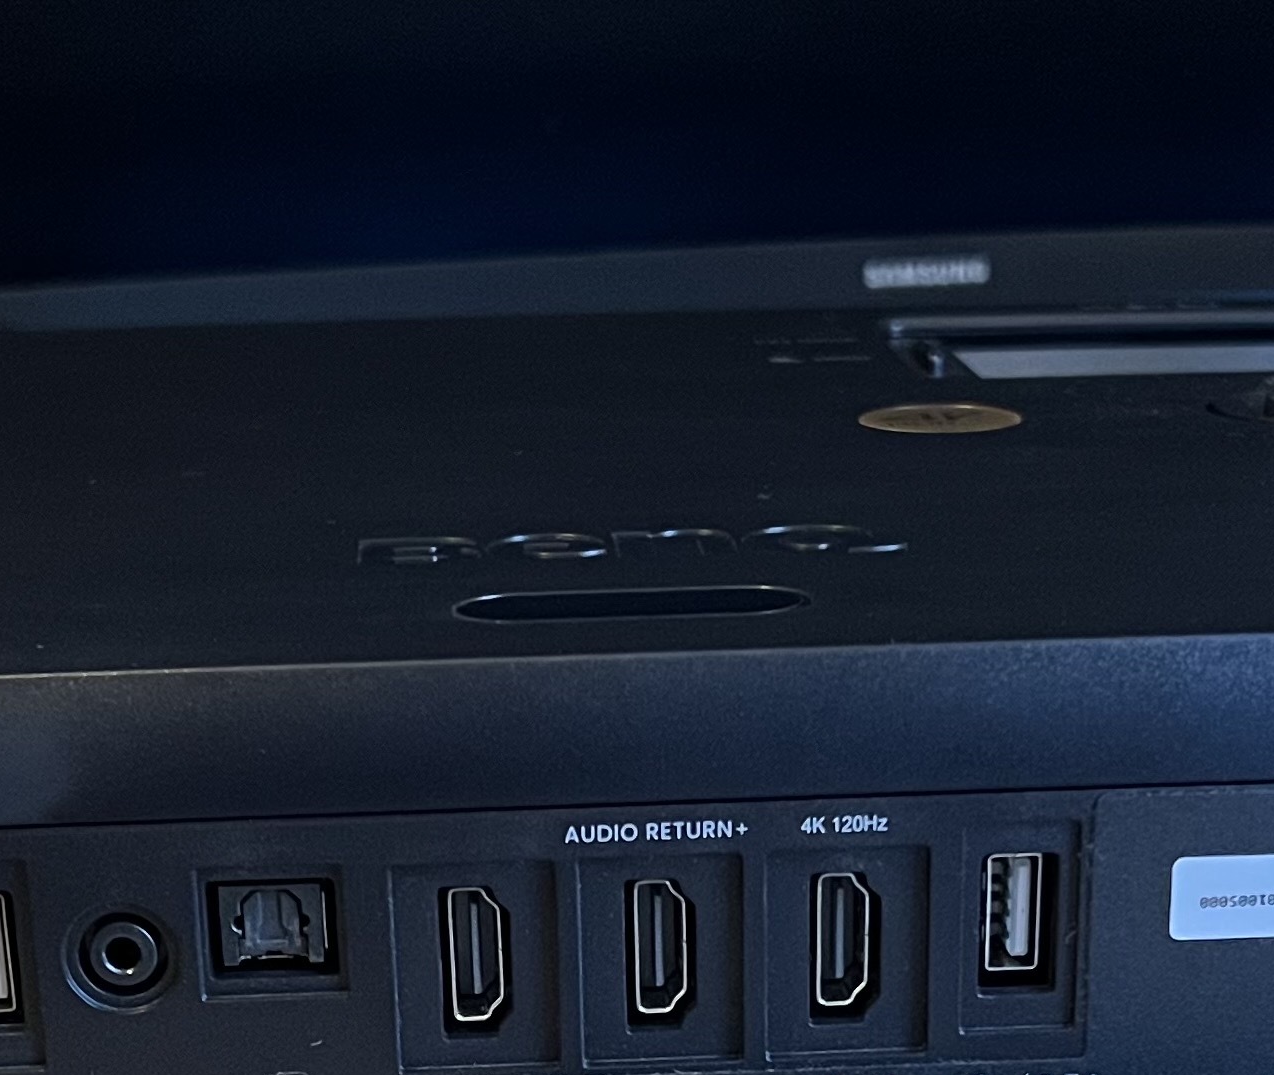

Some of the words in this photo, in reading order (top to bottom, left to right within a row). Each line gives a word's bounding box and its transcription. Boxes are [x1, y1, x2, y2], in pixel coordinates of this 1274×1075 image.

[564, 823, 638, 844] AUDIO
[645, 820, 749, 841] RETURN+
[800, 815, 826, 834] 4K
[832, 814, 889, 833] 120Hz
